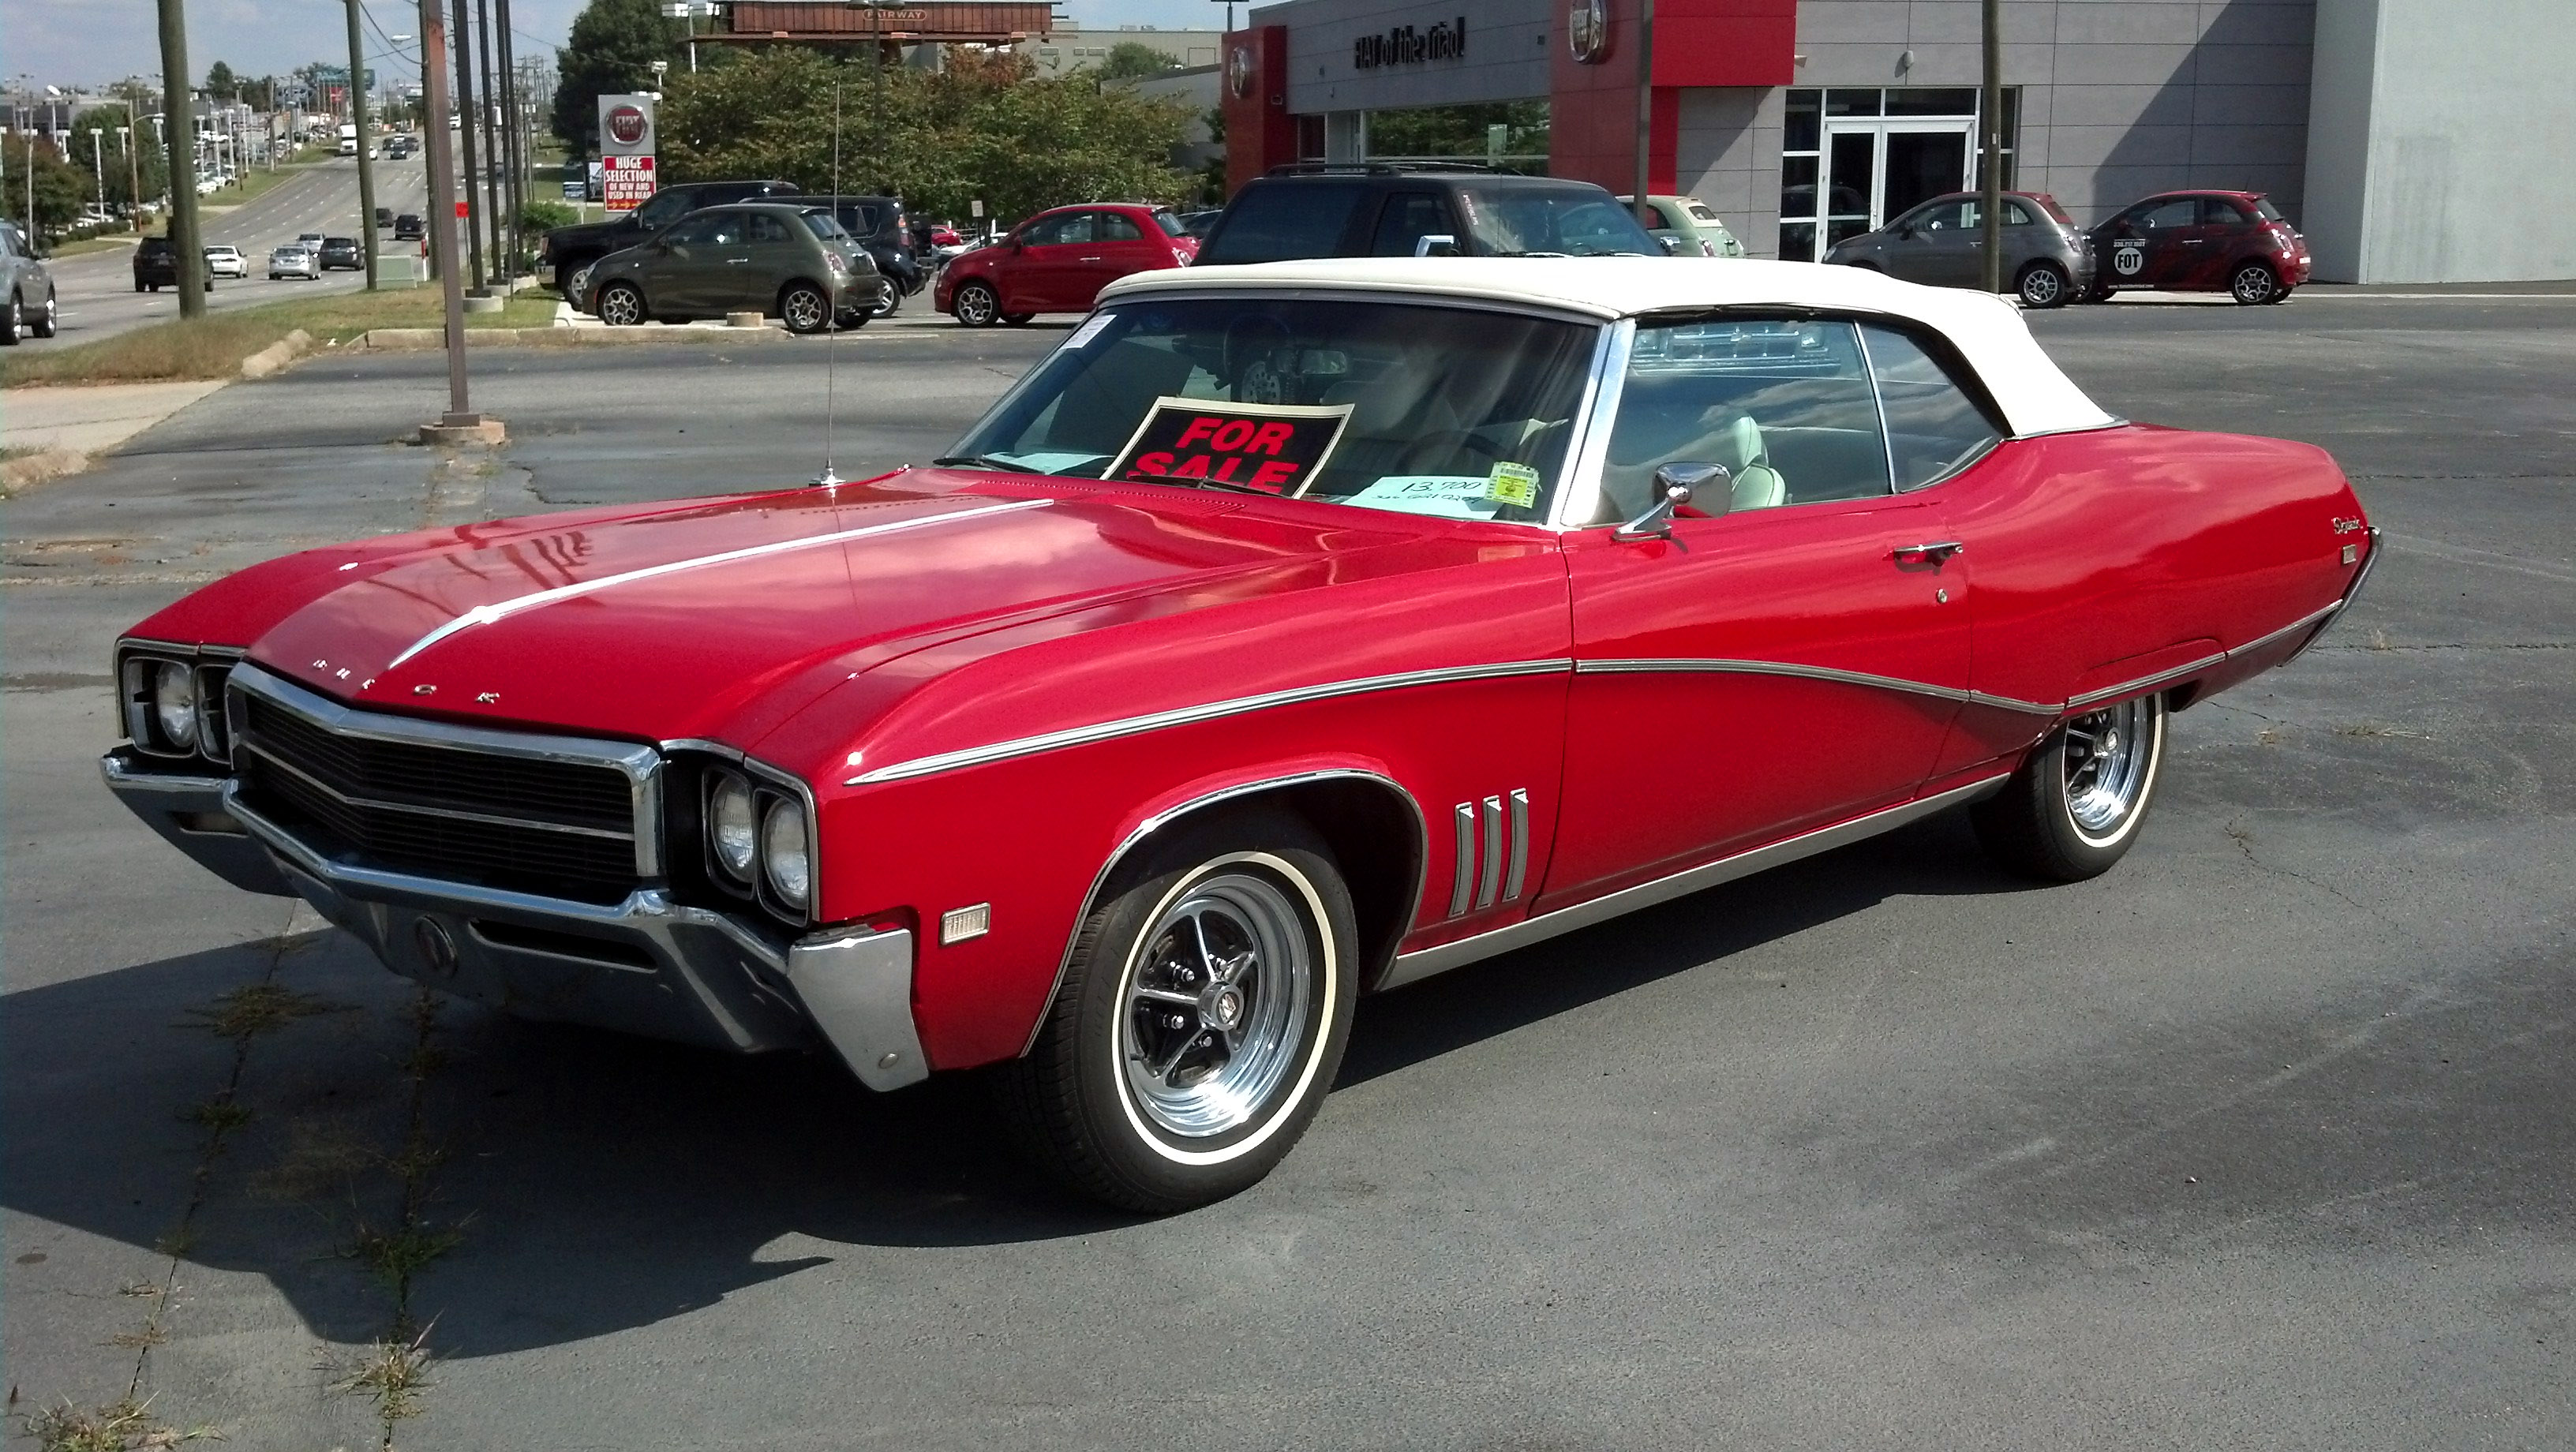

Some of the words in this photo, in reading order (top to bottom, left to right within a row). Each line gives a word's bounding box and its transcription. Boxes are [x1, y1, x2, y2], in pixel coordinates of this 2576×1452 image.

[1355, 35, 1383, 69] FIAT
[1400, 25, 1425, 63] the
[605, 170, 653, 182] SELECTION
[616, 158, 642, 170] HUGE
[2117, 254, 2140, 269] FOT
[1175, 417, 1294, 456] FOR
[1125, 451, 1299, 495] SALE
